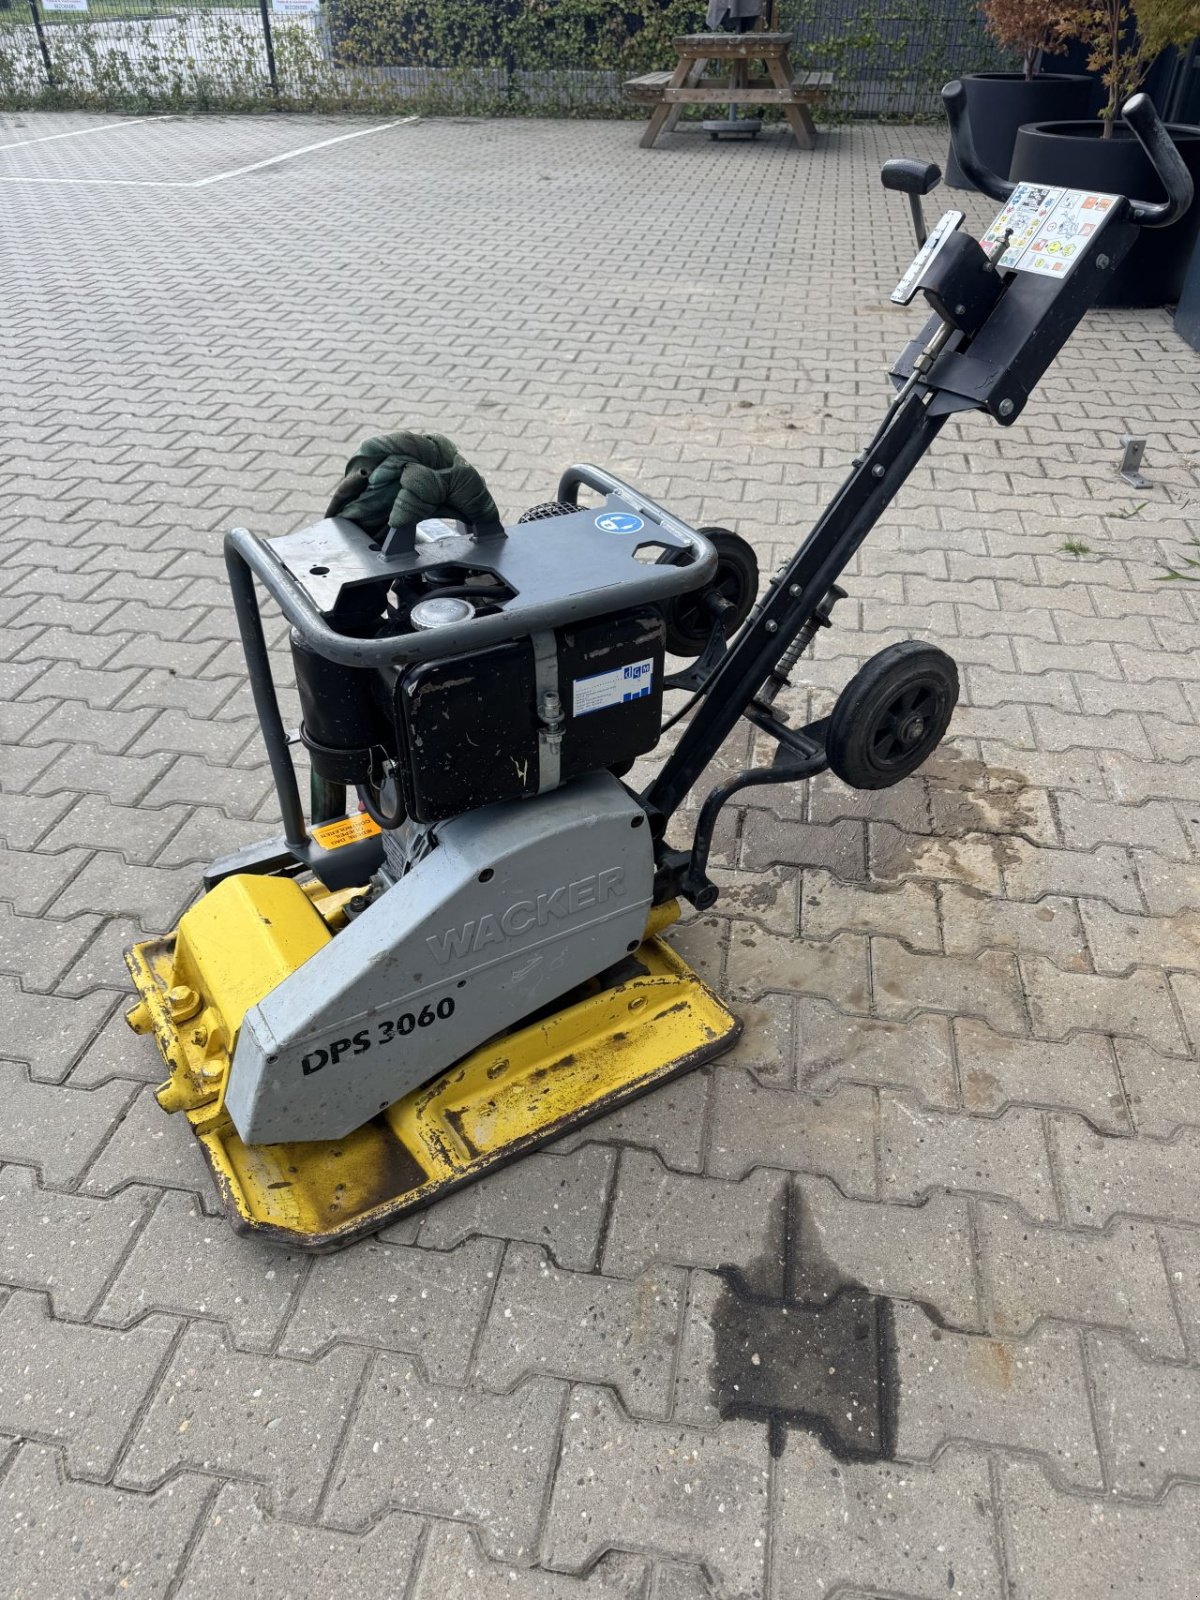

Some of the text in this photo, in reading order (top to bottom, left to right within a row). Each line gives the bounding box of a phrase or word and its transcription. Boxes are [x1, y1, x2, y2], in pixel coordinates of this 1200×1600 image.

[425, 866, 627, 966] WACKER
[301, 997, 456, 1077] DPS 3060
